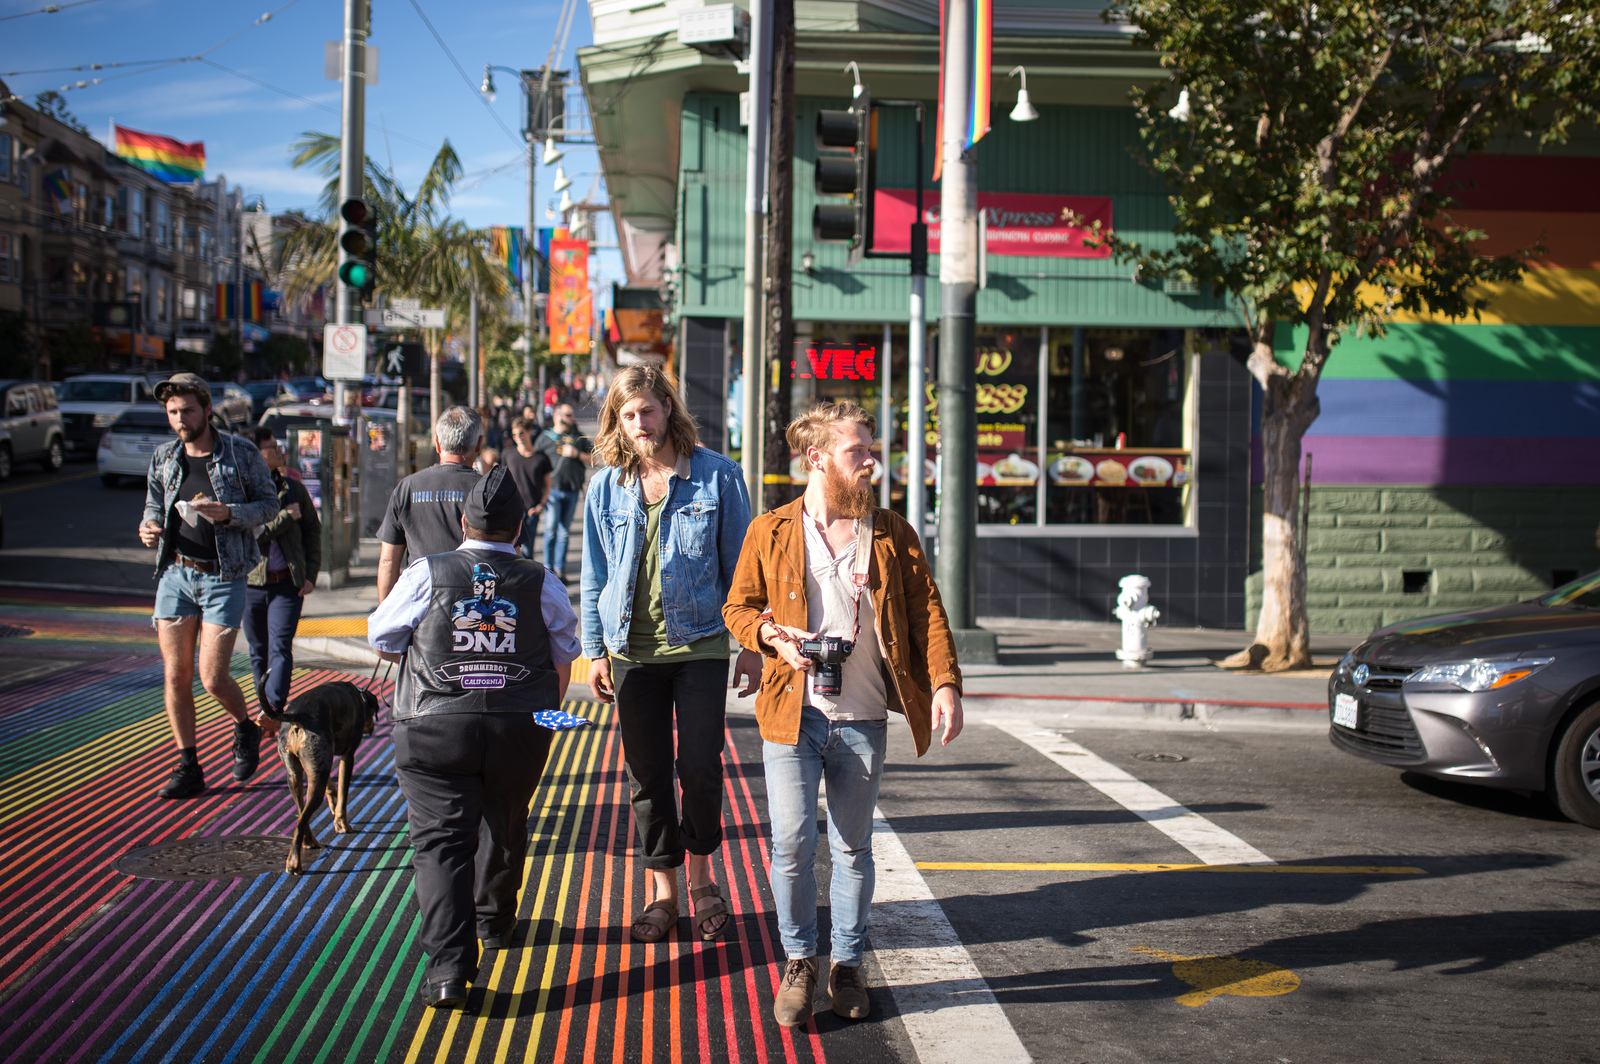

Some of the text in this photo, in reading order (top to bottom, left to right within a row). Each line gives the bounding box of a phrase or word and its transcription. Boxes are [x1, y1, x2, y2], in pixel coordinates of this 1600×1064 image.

[479, 623, 496, 631] 2016
[452, 630, 516, 653] DNA
[464, 678, 503, 686] CALIFORNIA
